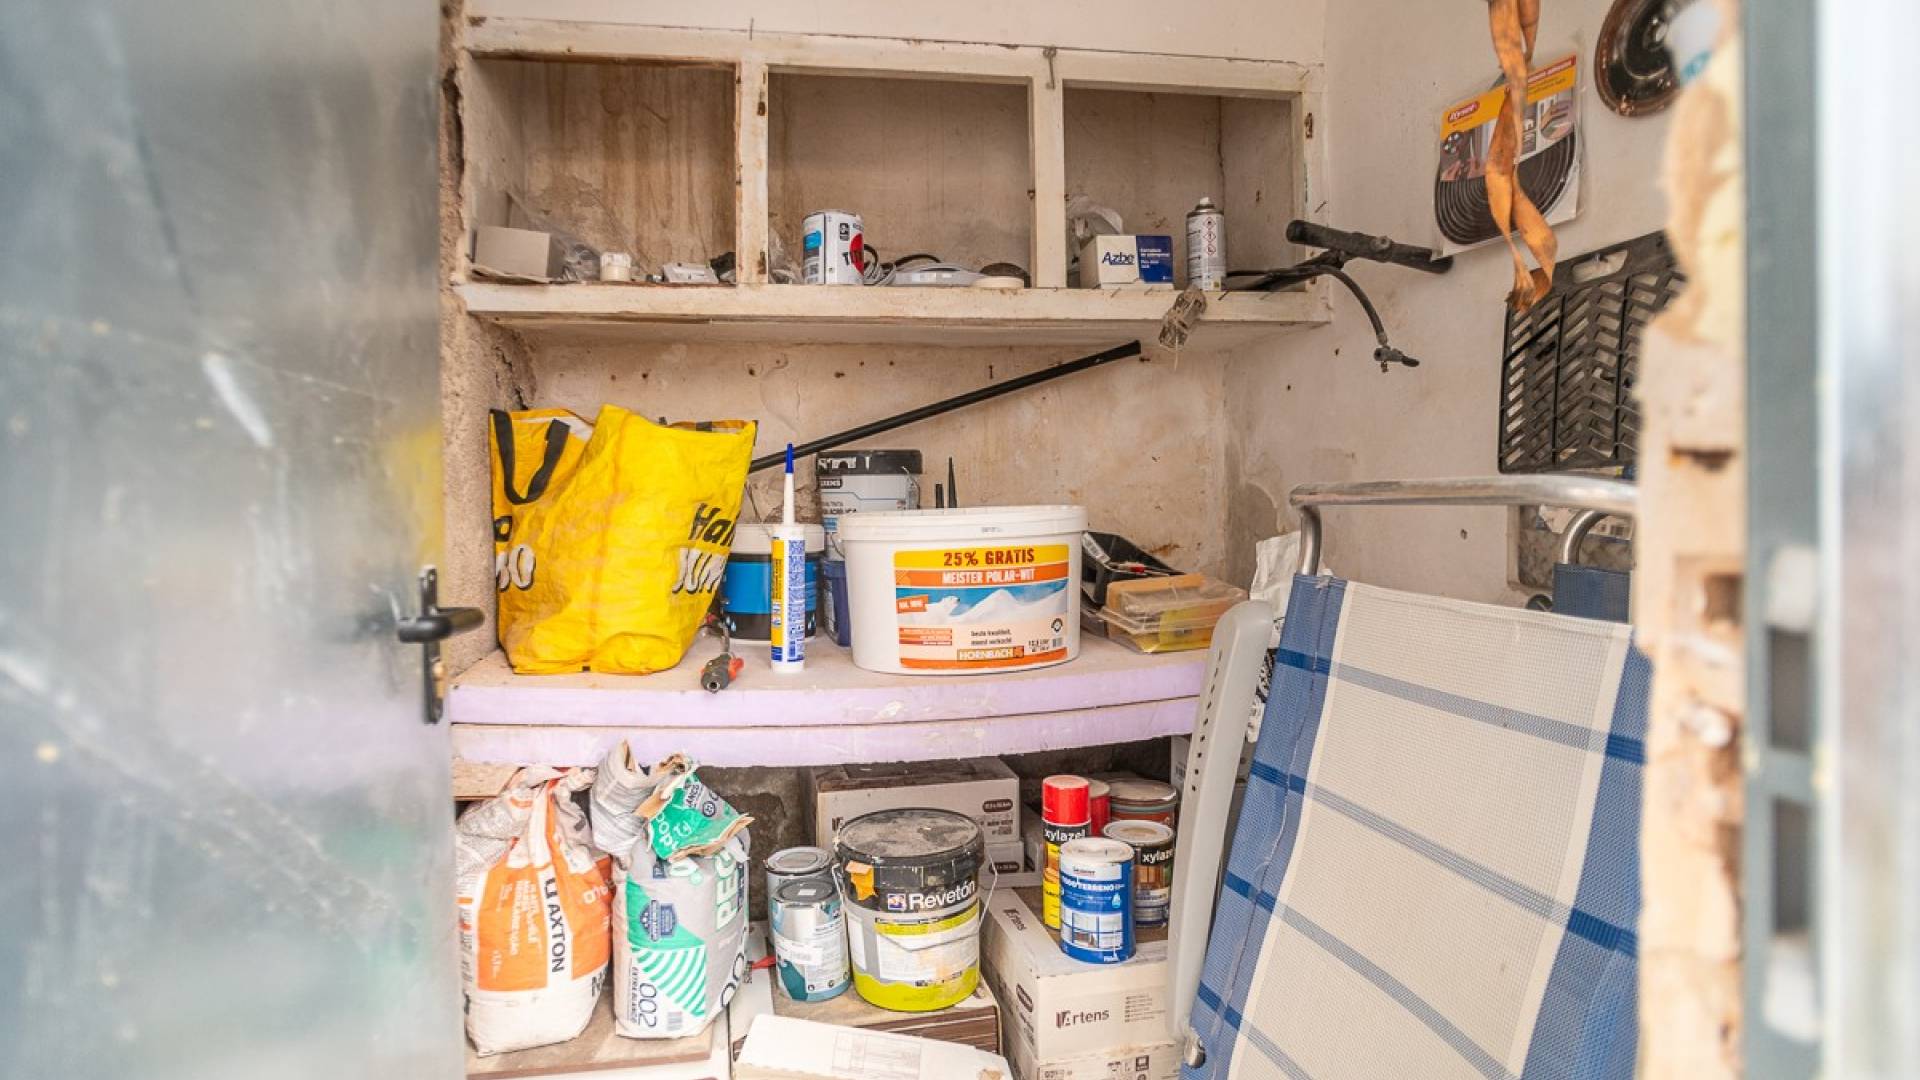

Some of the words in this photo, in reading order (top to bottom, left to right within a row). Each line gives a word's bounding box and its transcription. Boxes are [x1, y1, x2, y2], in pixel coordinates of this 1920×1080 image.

[1102, 251, 1135, 265] Azbe
[944, 551, 978, 566] 25%
[985, 548, 1035, 565] GRATIS
[942, 570, 983, 584] MEISTER
[986, 568, 1035, 583] POLAR-WIT
[959, 647, 1013, 660] HORNBACH
[909, 880, 975, 910] Revetón
[547, 904, 566, 973] AXTON
[639, 982, 657, 1028] 002
